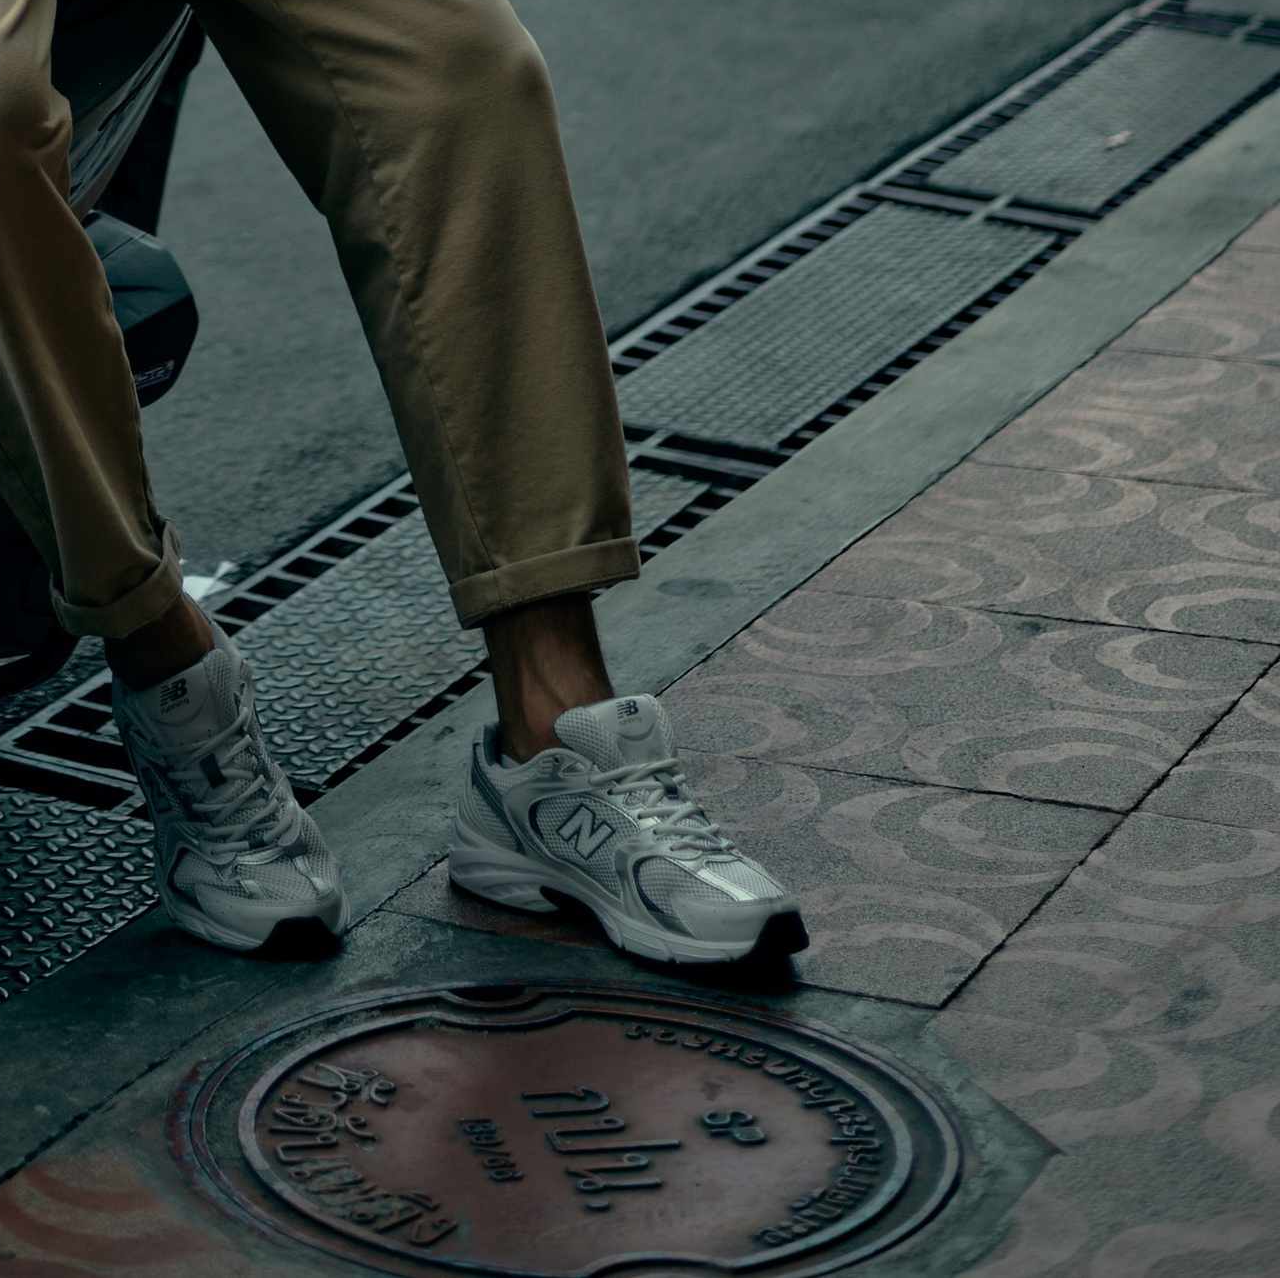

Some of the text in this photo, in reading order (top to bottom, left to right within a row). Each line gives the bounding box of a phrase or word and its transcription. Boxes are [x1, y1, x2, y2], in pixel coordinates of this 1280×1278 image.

[160, 697, 190, 714] running
[556, 803, 617, 859] N
[523, 1086, 681, 1210] กปน.
[702, 1109, 765, 1145] SP
